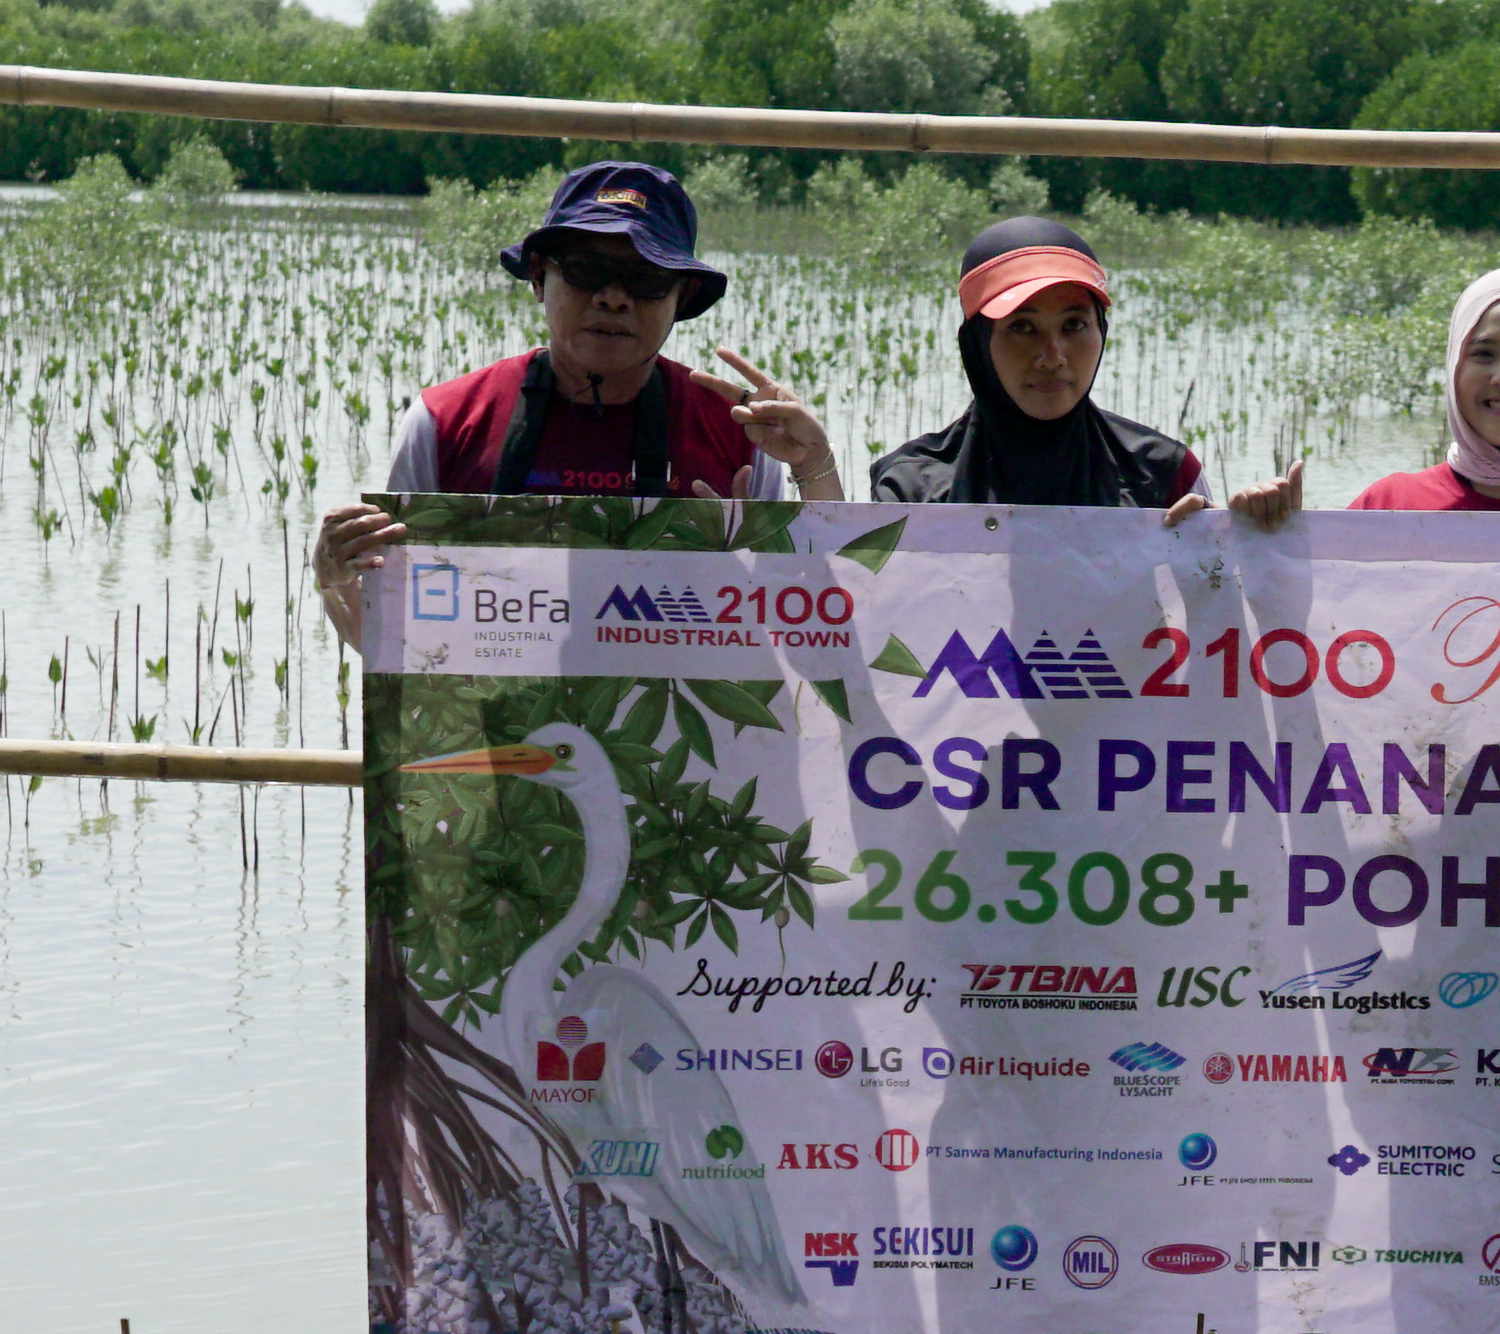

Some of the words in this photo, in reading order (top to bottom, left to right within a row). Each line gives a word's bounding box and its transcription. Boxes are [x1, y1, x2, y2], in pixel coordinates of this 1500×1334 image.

[563, 470, 621, 489] 2100
[474, 589, 570, 624] BeFa
[474, 631, 554, 643] INDUSTRIAL
[597, 626, 760, 647] INDUSTRIAL
[768, 630, 851, 648] TOWN
[475, 648, 523, 659] ESTATE
[848, 736, 1062, 811] CSR
[848, 848, 1249, 926] 26.308+
[677, 958, 877, 1013] Supported
[877, 961, 936, 1013] by:
[960, 998, 974, 1008] PT
[977, 998, 1019, 1009] TOYOTA
[1023, 999, 1075, 1009] BOSHOKU
[1079, 1000, 1137, 1010] INDONESIA
[1259, 990, 1325, 1009] Yusen
[1332, 990, 1430, 1014] Logistics
[676, 1049, 802, 1071] SHINSEI
[861, 1047, 902, 1073] LG
[960, 1056, 994, 1075] Air
[1000, 1056, 1090, 1081] Liquide
[1238, 1055, 1346, 1083] YAMAHA
[860, 1078, 883, 1087] Life's
[886, 1078, 909, 1087] Good
[1120, 1087, 1173, 1096] LYSAGHT
[1476, 1078, 1492, 1087] PT.
[777, 1143, 858, 1169] AKS
[926, 1146, 942, 1158] PT
[946, 1147, 990, 1159] Sanwa
[994, 1147, 1094, 1163] Manufacturing
[1098, 1148, 1163, 1161] Indonesia
[1378, 1145, 1476, 1160] SUMITOMO
[683, 1165, 764, 1179] nutrifood
[1378, 1162, 1465, 1177] ELECTRIC
[1178, 1175, 1215, 1186] JFE
[805, 1233, 859, 1256] NSK
[873, 1227, 973, 1255] SEKISUI
[1073, 1252, 1109, 1273] MIL
[1254, 1241, 1320, 1267] FNI
[1374, 1249, 1463, 1264] TSUCHIYA
[911, 1261, 973, 1269] POLYMATECH
[990, 1278, 1035, 1291] JFE
